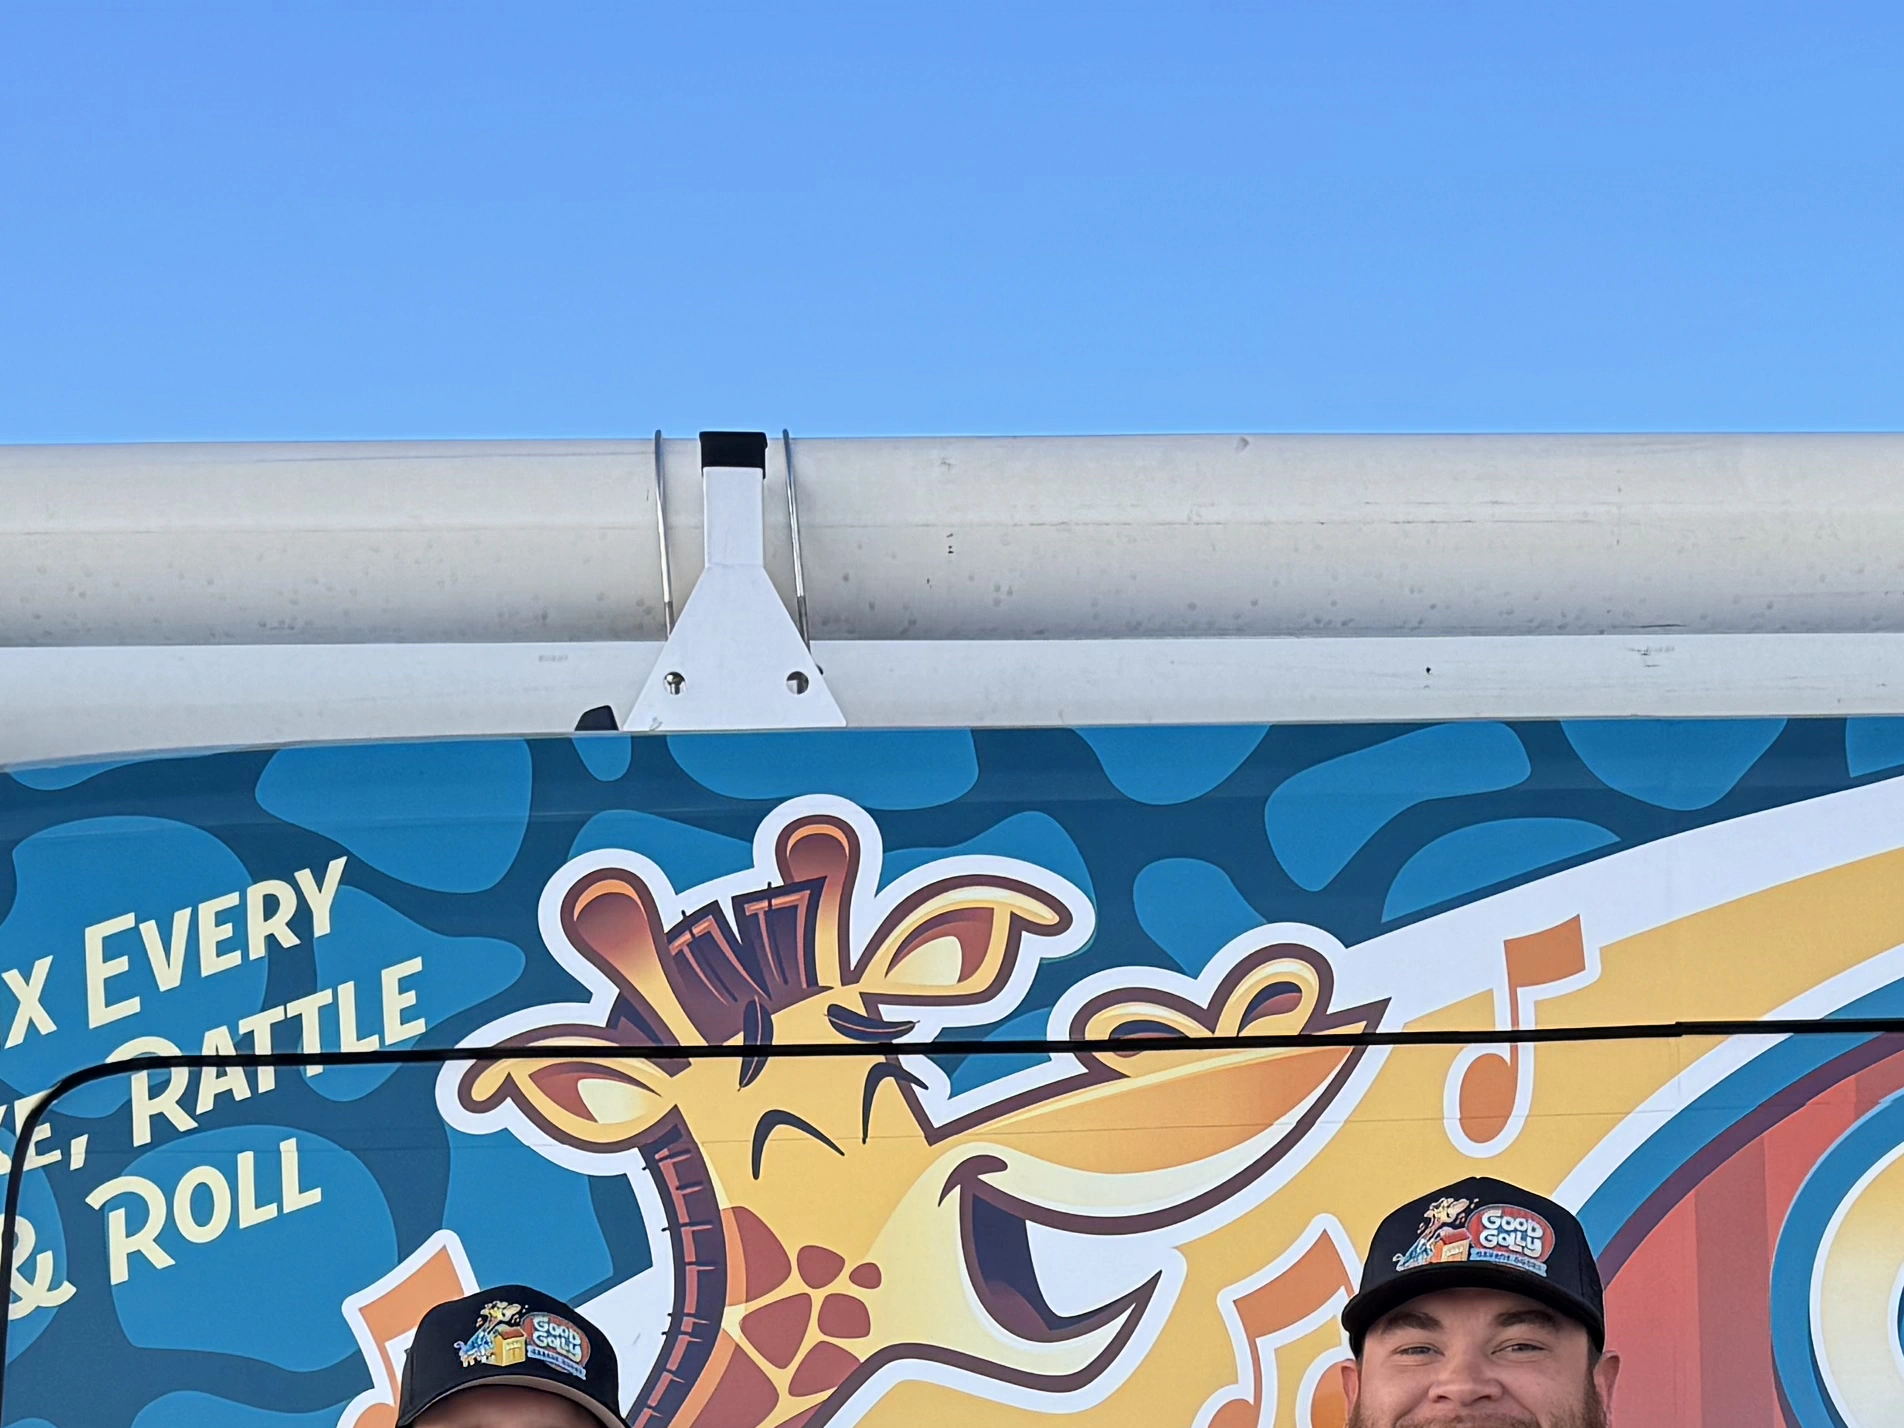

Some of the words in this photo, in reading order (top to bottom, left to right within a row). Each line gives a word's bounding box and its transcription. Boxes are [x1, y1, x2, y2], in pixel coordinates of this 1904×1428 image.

[85, 856, 347, 1029] EVERY
[105, 957, 427, 1147] RATTLE
[85, 1137, 322, 1285] ROLL
[1481, 1209, 1543, 1238] GOOD
[1480, 1229, 1542, 1258] GOLLY
[533, 1315, 581, 1345] GOOD
[533, 1331, 582, 1362] GOLLY
